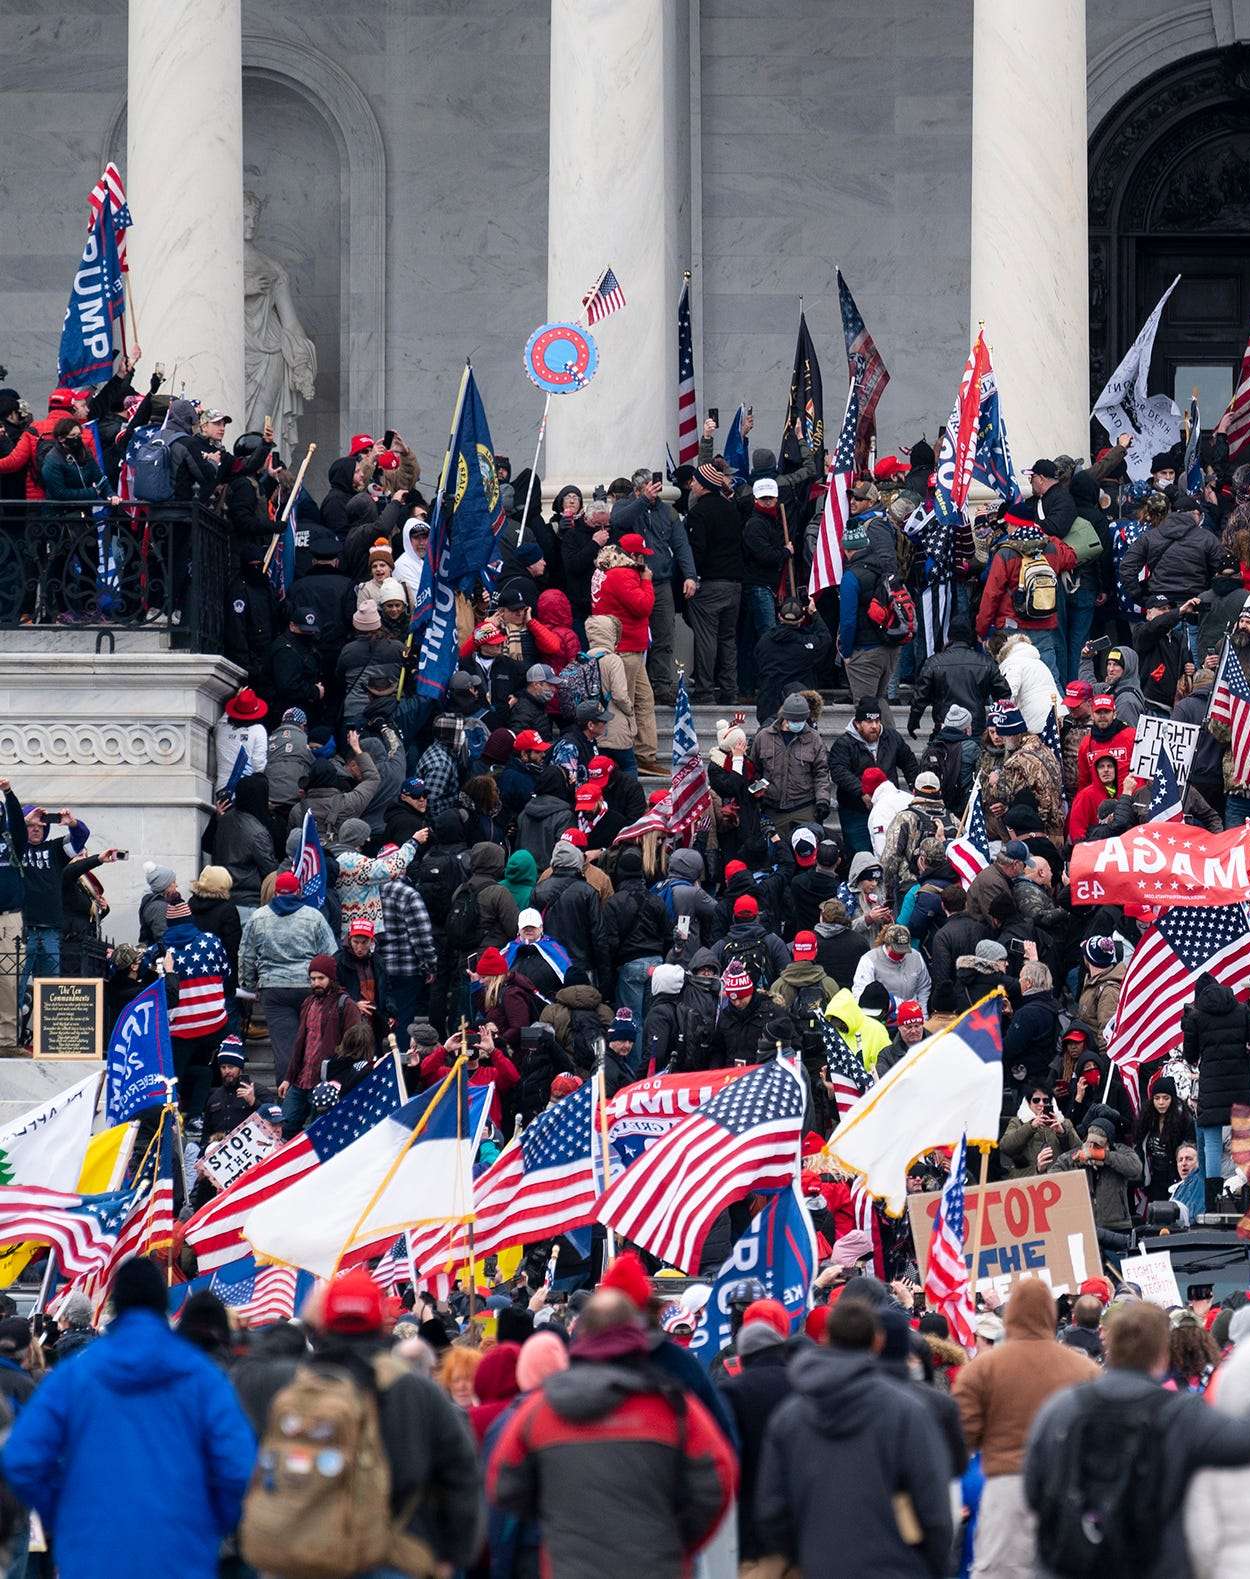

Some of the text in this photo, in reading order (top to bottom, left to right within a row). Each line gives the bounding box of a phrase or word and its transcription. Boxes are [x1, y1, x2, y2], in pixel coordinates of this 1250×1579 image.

[72, 234, 110, 358] RUMP
[1142, 718, 1195, 746] FIGHT
[1087, 748, 1126, 764] TMP
[1150, 740, 1186, 762] LKE
[1136, 755, 1190, 783] FLNN
[208, 1126, 253, 1172] STOP
[225, 1148, 252, 1173] THE
